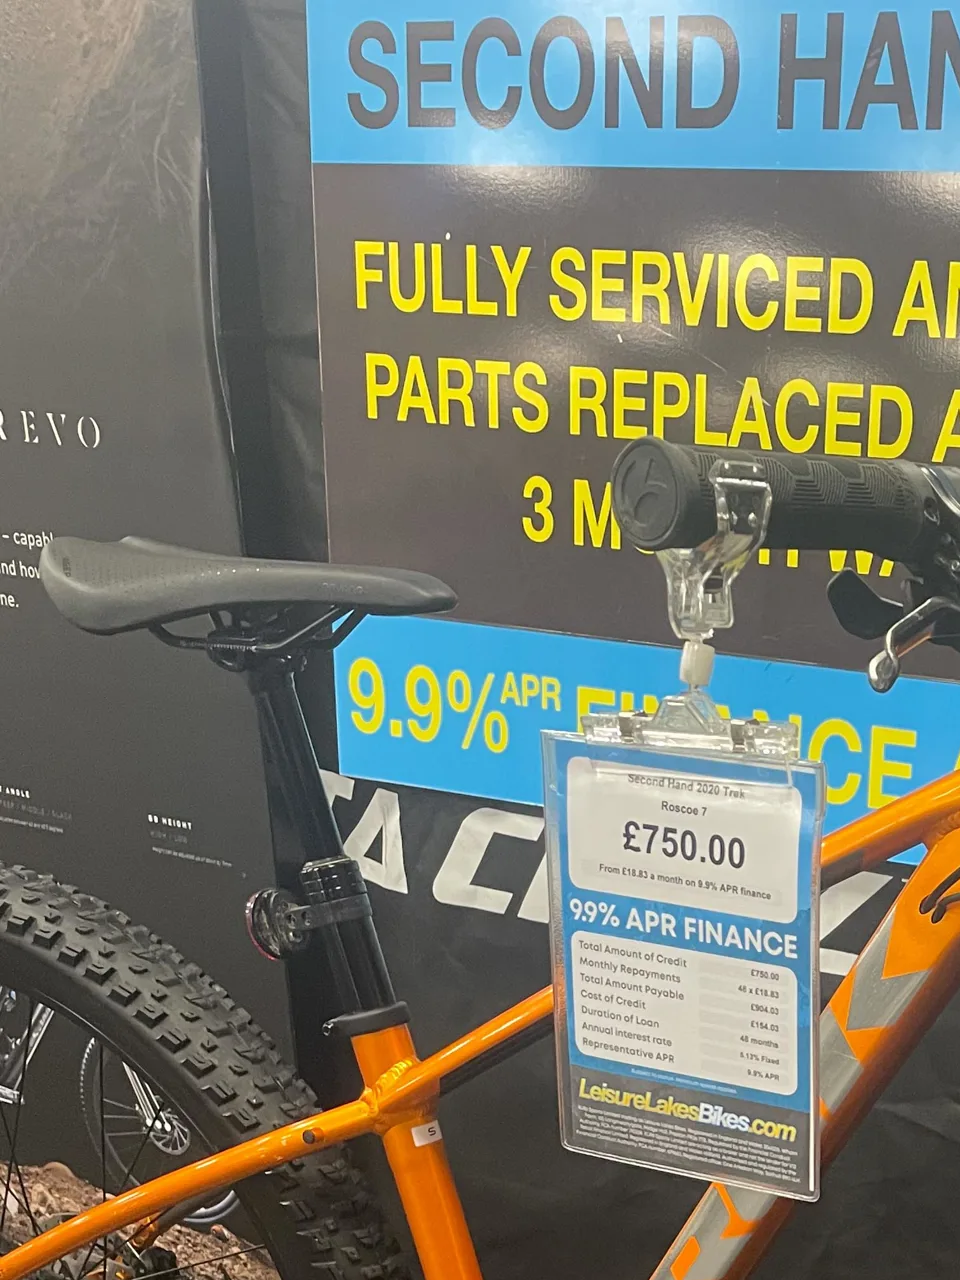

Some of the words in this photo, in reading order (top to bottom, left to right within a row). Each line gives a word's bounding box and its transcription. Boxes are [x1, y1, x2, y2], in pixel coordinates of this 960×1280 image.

[347, 14, 740, 130] SECOND
[354, 240, 531, 317] FULLY
[549, 246, 873, 334] SERVICED
[365, 352, 548, 433] PARTS
[569, 366, 913, 459] REPLACED
[522, 475, 553, 543] 3
[348, 657, 509, 754] 9.9%
[500, 671, 561, 711] APR
[628, 773, 664, 788] Second
[667, 776, 694, 792] Hand
[696, 782, 720, 796] 2020
[723, 786, 746, 799] Trek
[661, 800, 699, 816] Roscoe
[701, 806, 708, 816] 7
[623, 820, 746, 869] £750.00
[599, 863, 620, 875] From
[622, 867, 648, 880] £18.83
[657, 873, 683, 886] month
[685, 878, 696, 888] on
[697, 880, 718, 891] 9.9%
[719, 884, 739, 895] APR
[740, 887, 772, 901] finance
[625, 907, 677, 938] APR
[684, 917, 798, 959] FINANCE
[579, 940, 602, 952] Total
[604, 945, 642, 960] Amount
[644, 952, 655, 961] of
[656, 954, 687, 968] Credit
[579, 956, 618, 973] Monthly
[620, 964, 681, 984] Repayments
[750, 968, 780, 981] £750.00
[580, 972, 603, 985] Total
[605, 978, 643, 993] Amount
[645, 985, 685, 1001] Payable
[581, 989, 602, 1002] Cost
[604, 994, 614, 1003] of
[616, 996, 646, 1010] Credit
[581, 1005, 622, 1021] Duration
[624, 1014, 634, 1023] of
[636, 1016, 660, 1028] Loan
[750, 1003, 780, 1016] £904.03
[582, 1021, 613, 1035] Annual
[652, 1036, 673, 1047] rate
[750, 1037, 779, 1049] months
[582, 1037, 654, 1060] Representative
[655, 1052, 675, 1064] APR
[764, 1072, 780, 1082] APR
[578, 1077, 797, 1142] LeisureLakesBikes.com
[427, 1125, 436, 1136] S
